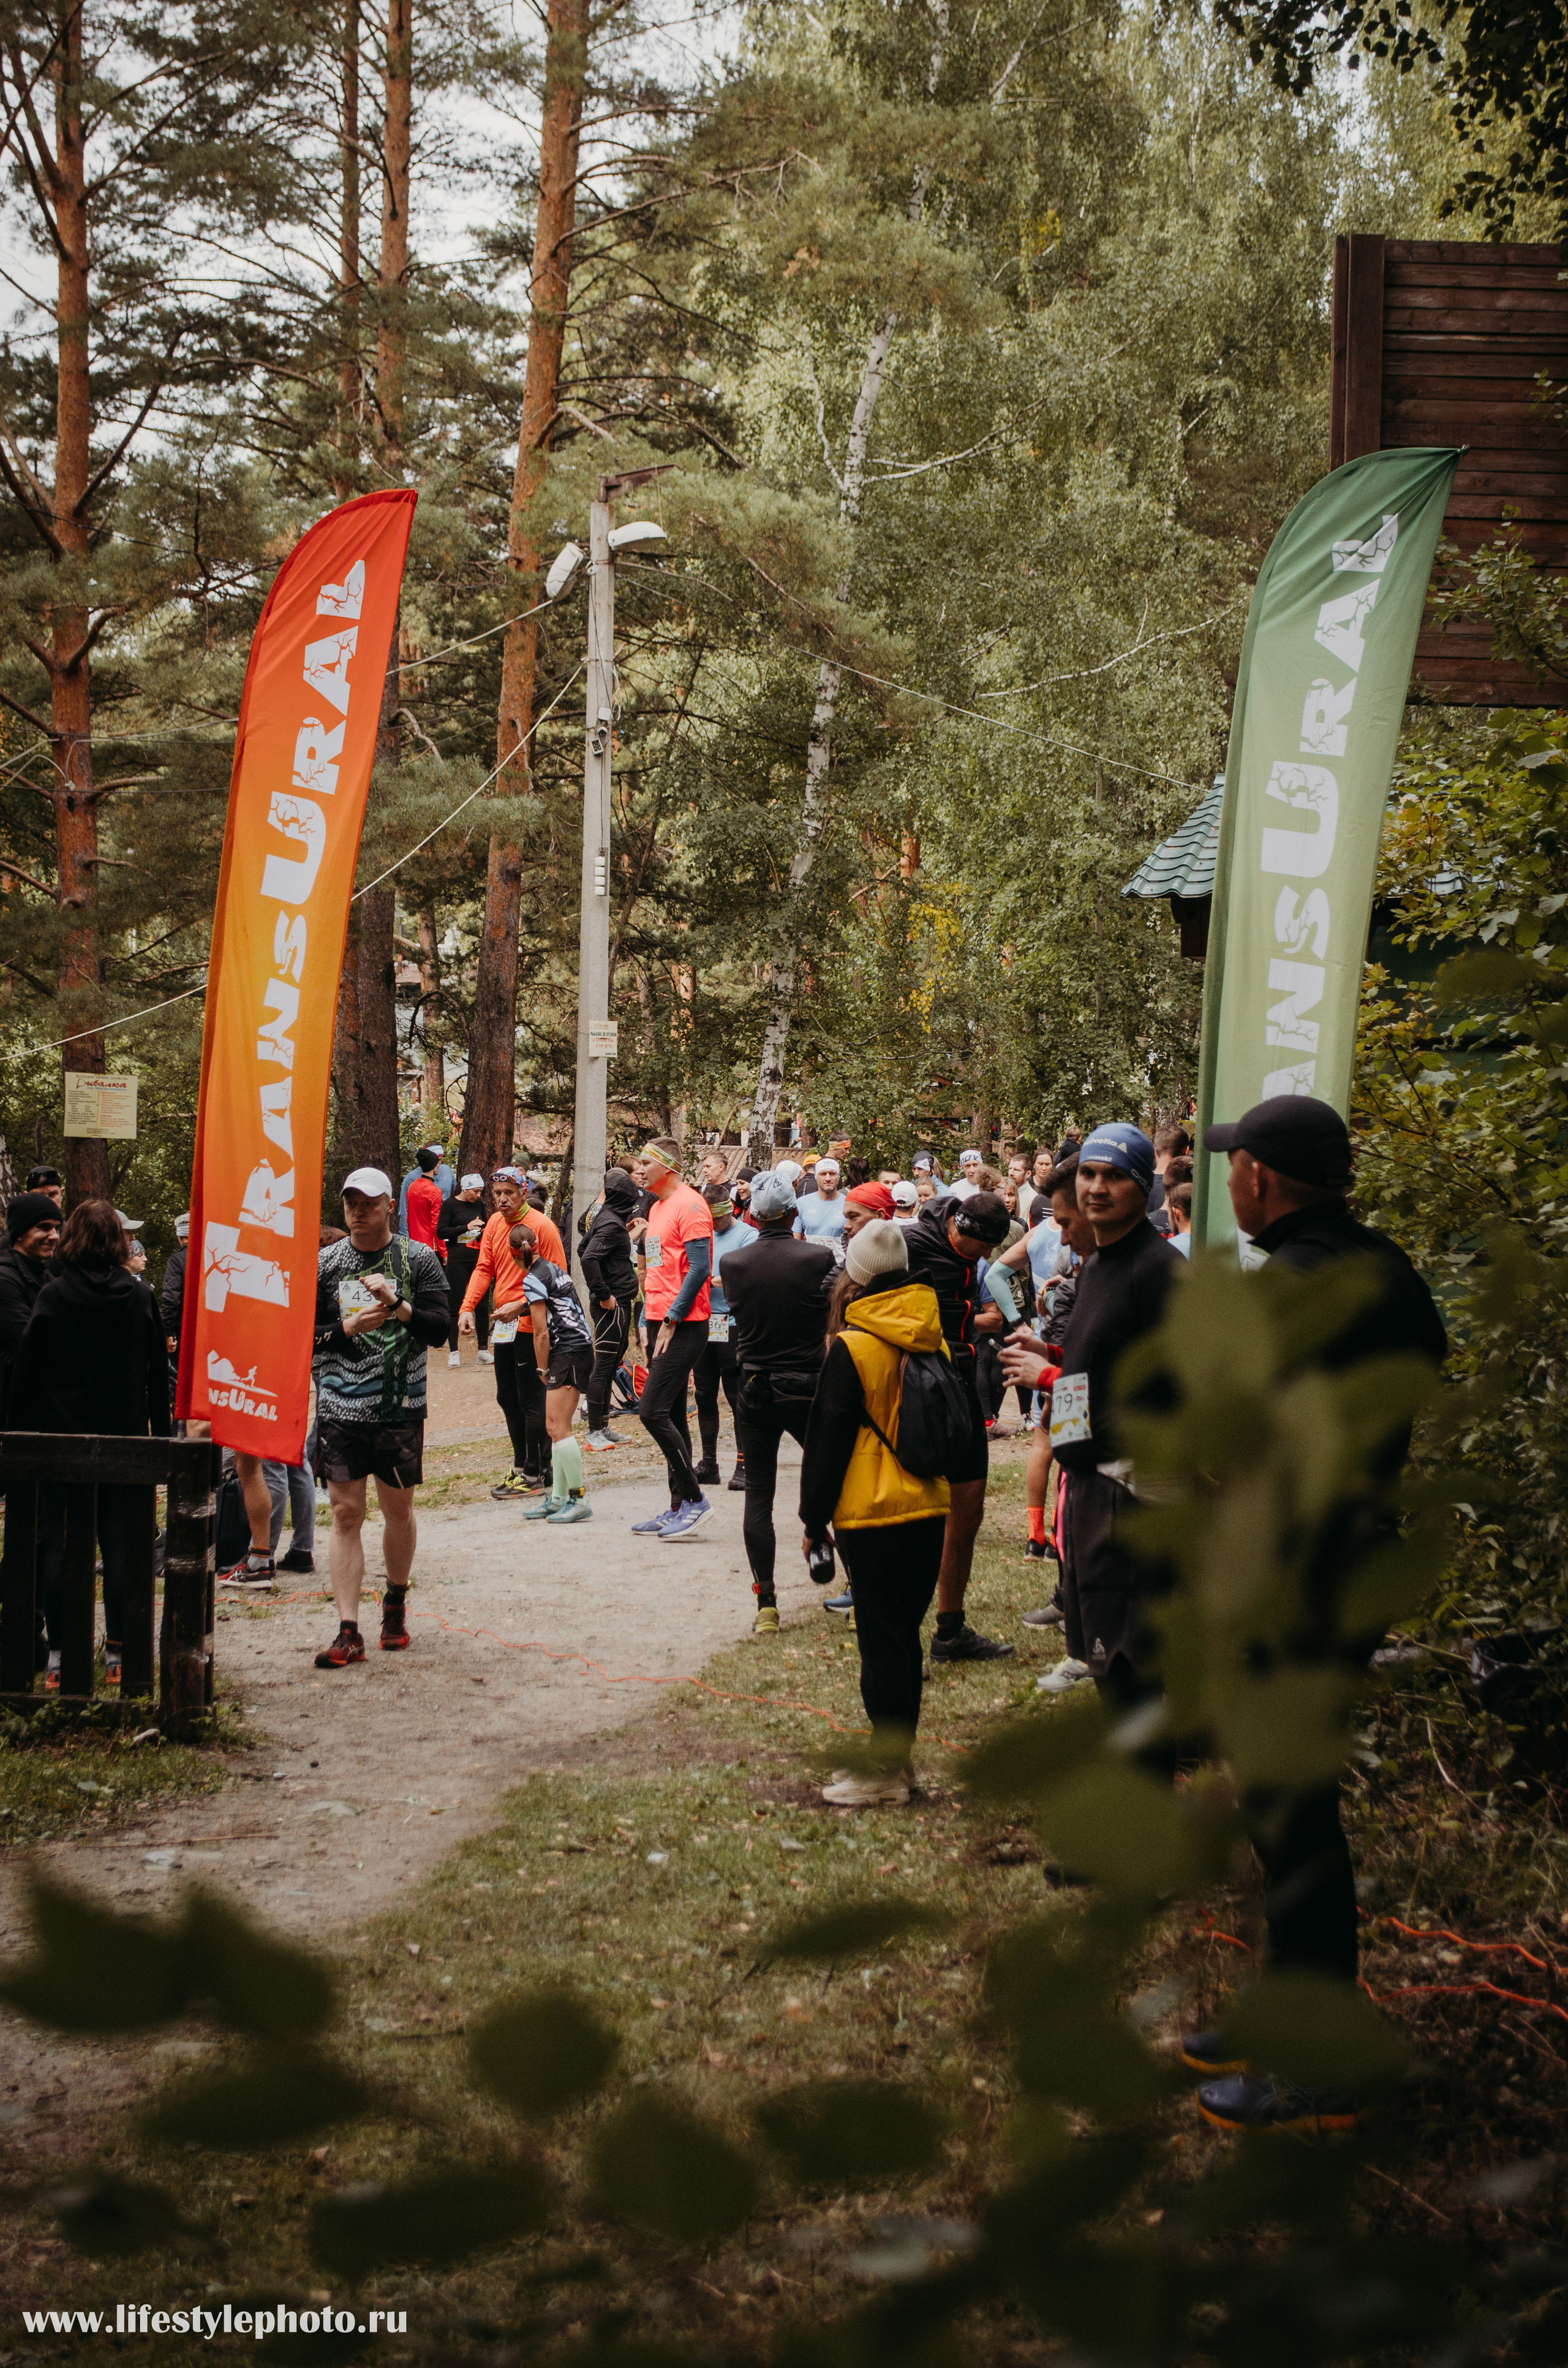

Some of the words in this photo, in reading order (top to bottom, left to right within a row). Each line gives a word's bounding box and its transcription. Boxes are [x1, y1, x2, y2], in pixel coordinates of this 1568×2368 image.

[205, 559, 365, 1312] TRANSURAL
[352, 1291, 372, 1302] 43
[208, 1387, 278, 1421] NSURAL
[1052, 1393, 1072, 1413] 79
